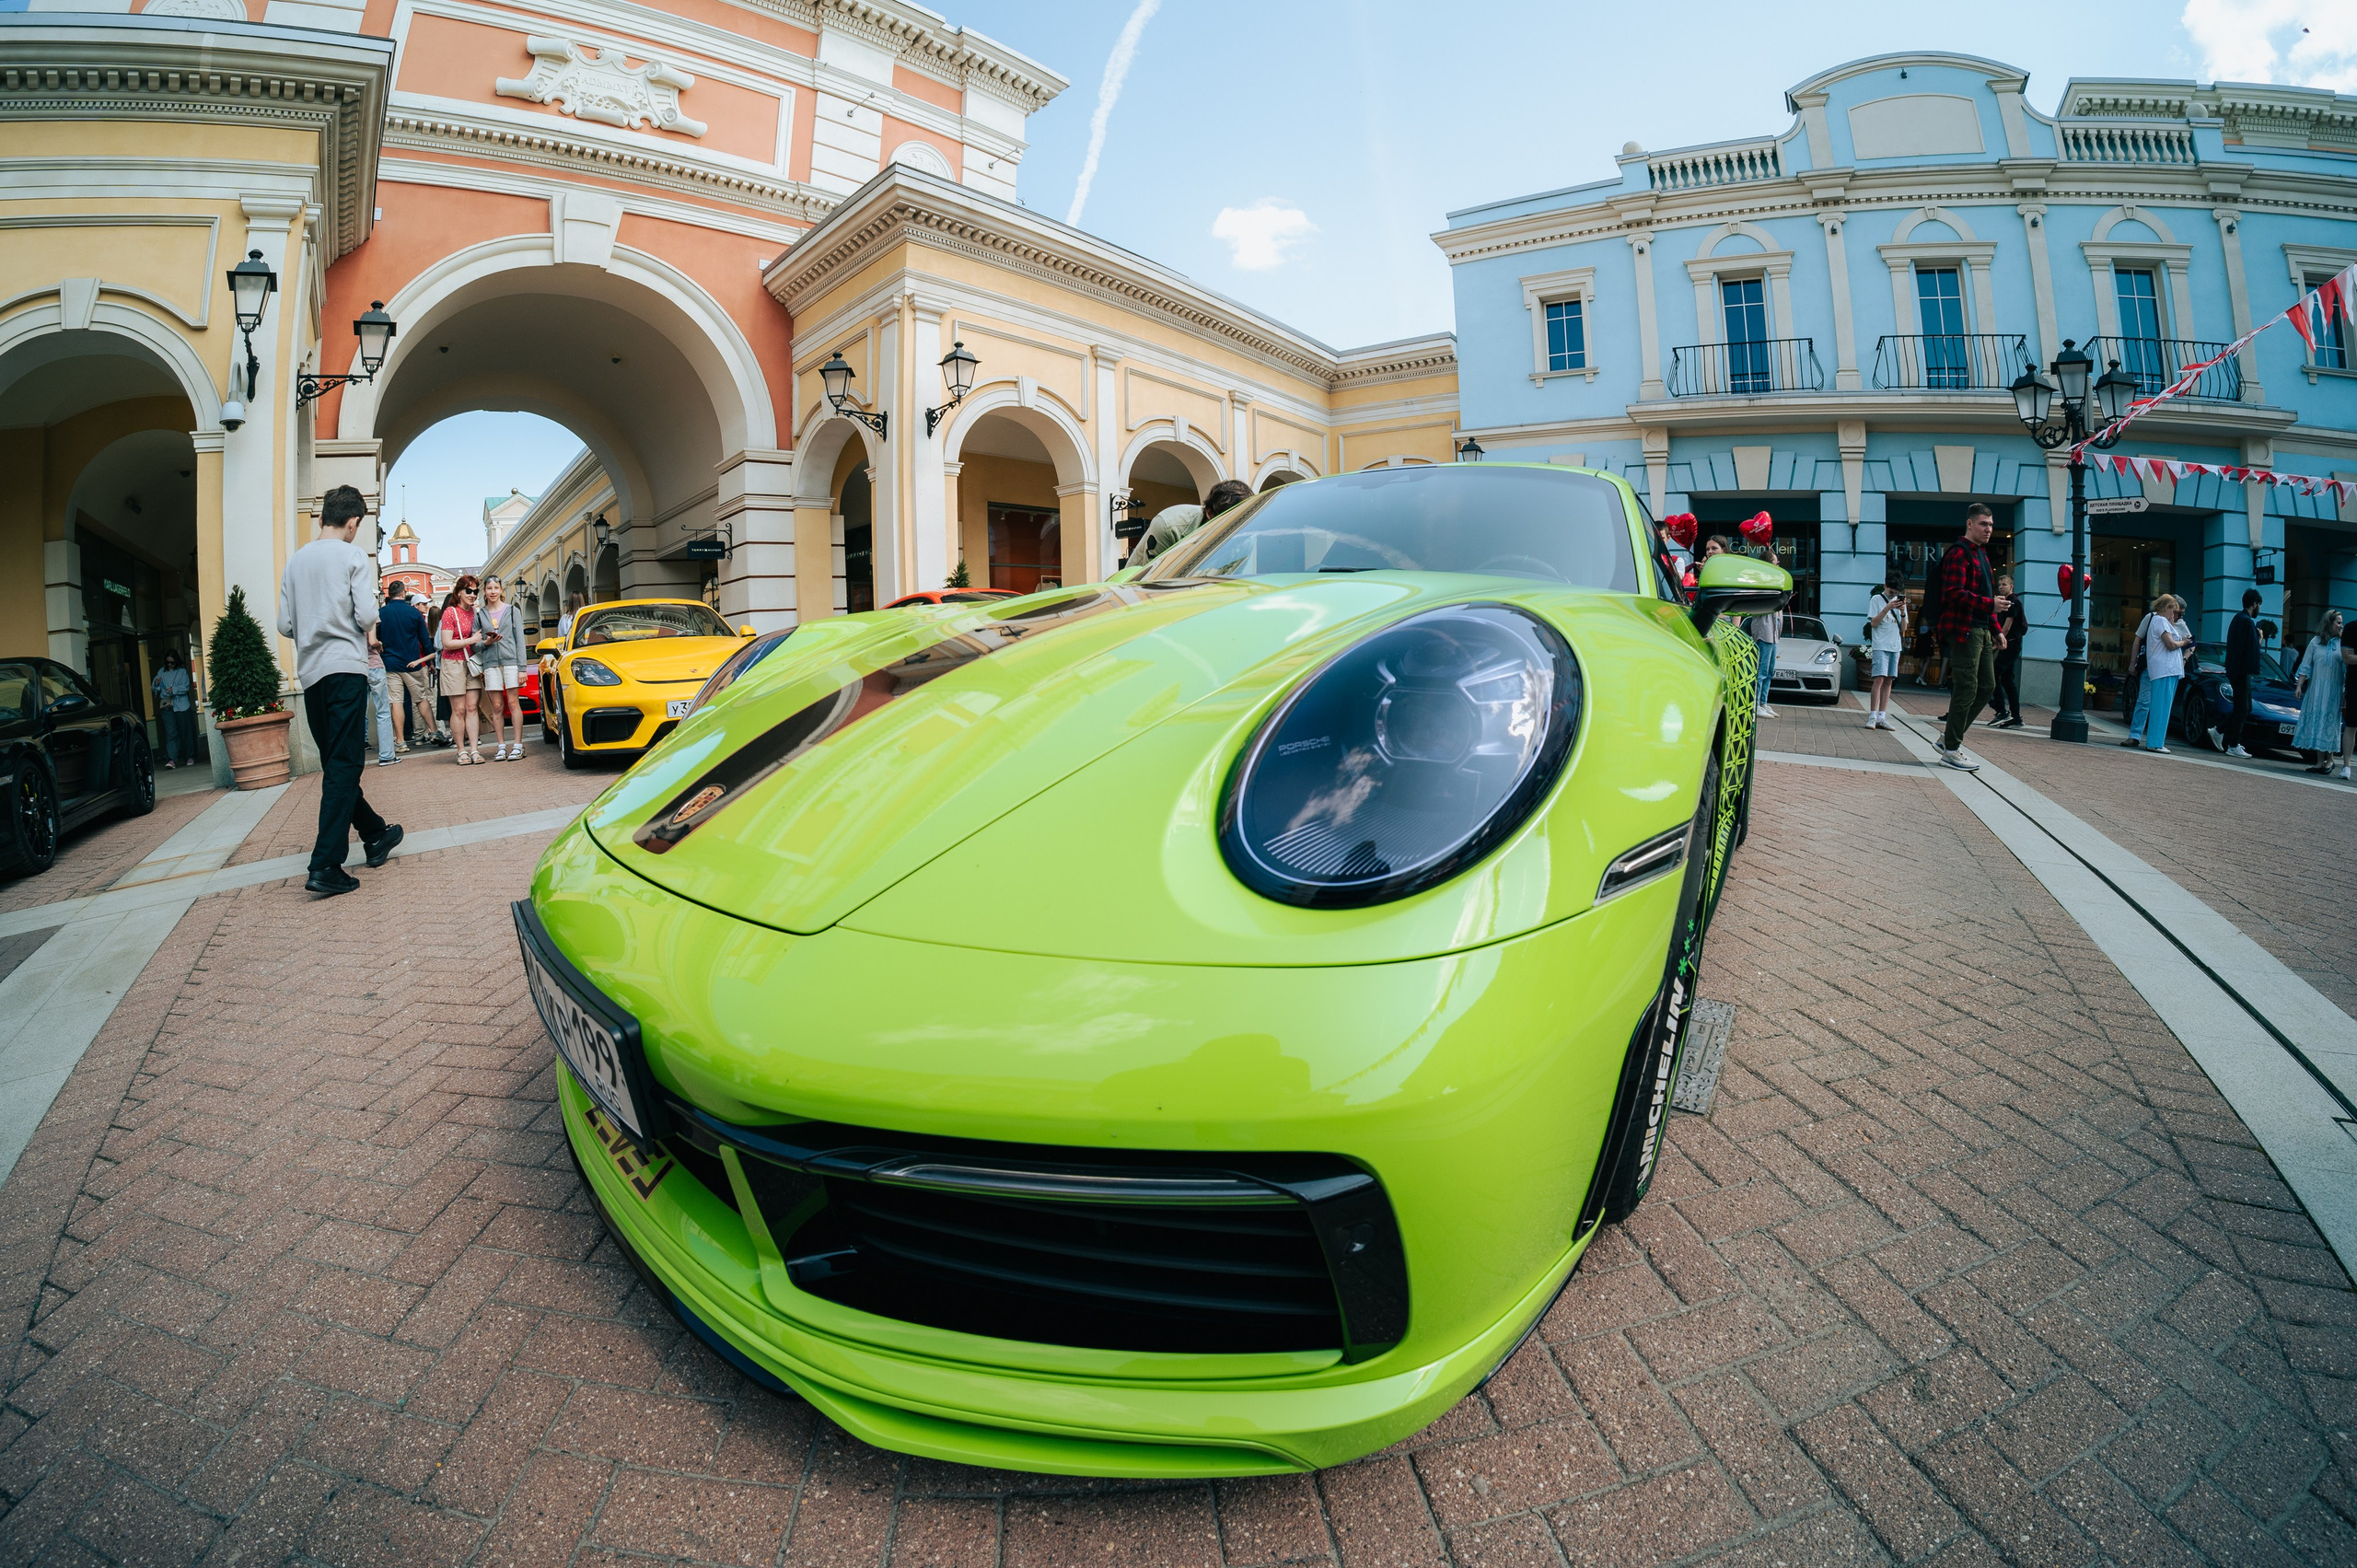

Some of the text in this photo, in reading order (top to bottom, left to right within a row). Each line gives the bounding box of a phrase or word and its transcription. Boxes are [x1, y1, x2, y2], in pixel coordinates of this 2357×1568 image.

[1729, 540, 1796, 554] Calvin Klein
[1278, 736, 1330, 751] PORSCHE
[572, 1006, 617, 1089] 199
[1640, 977, 1684, 1167] MICHELIN
[595, 1073, 622, 1112] RUS
